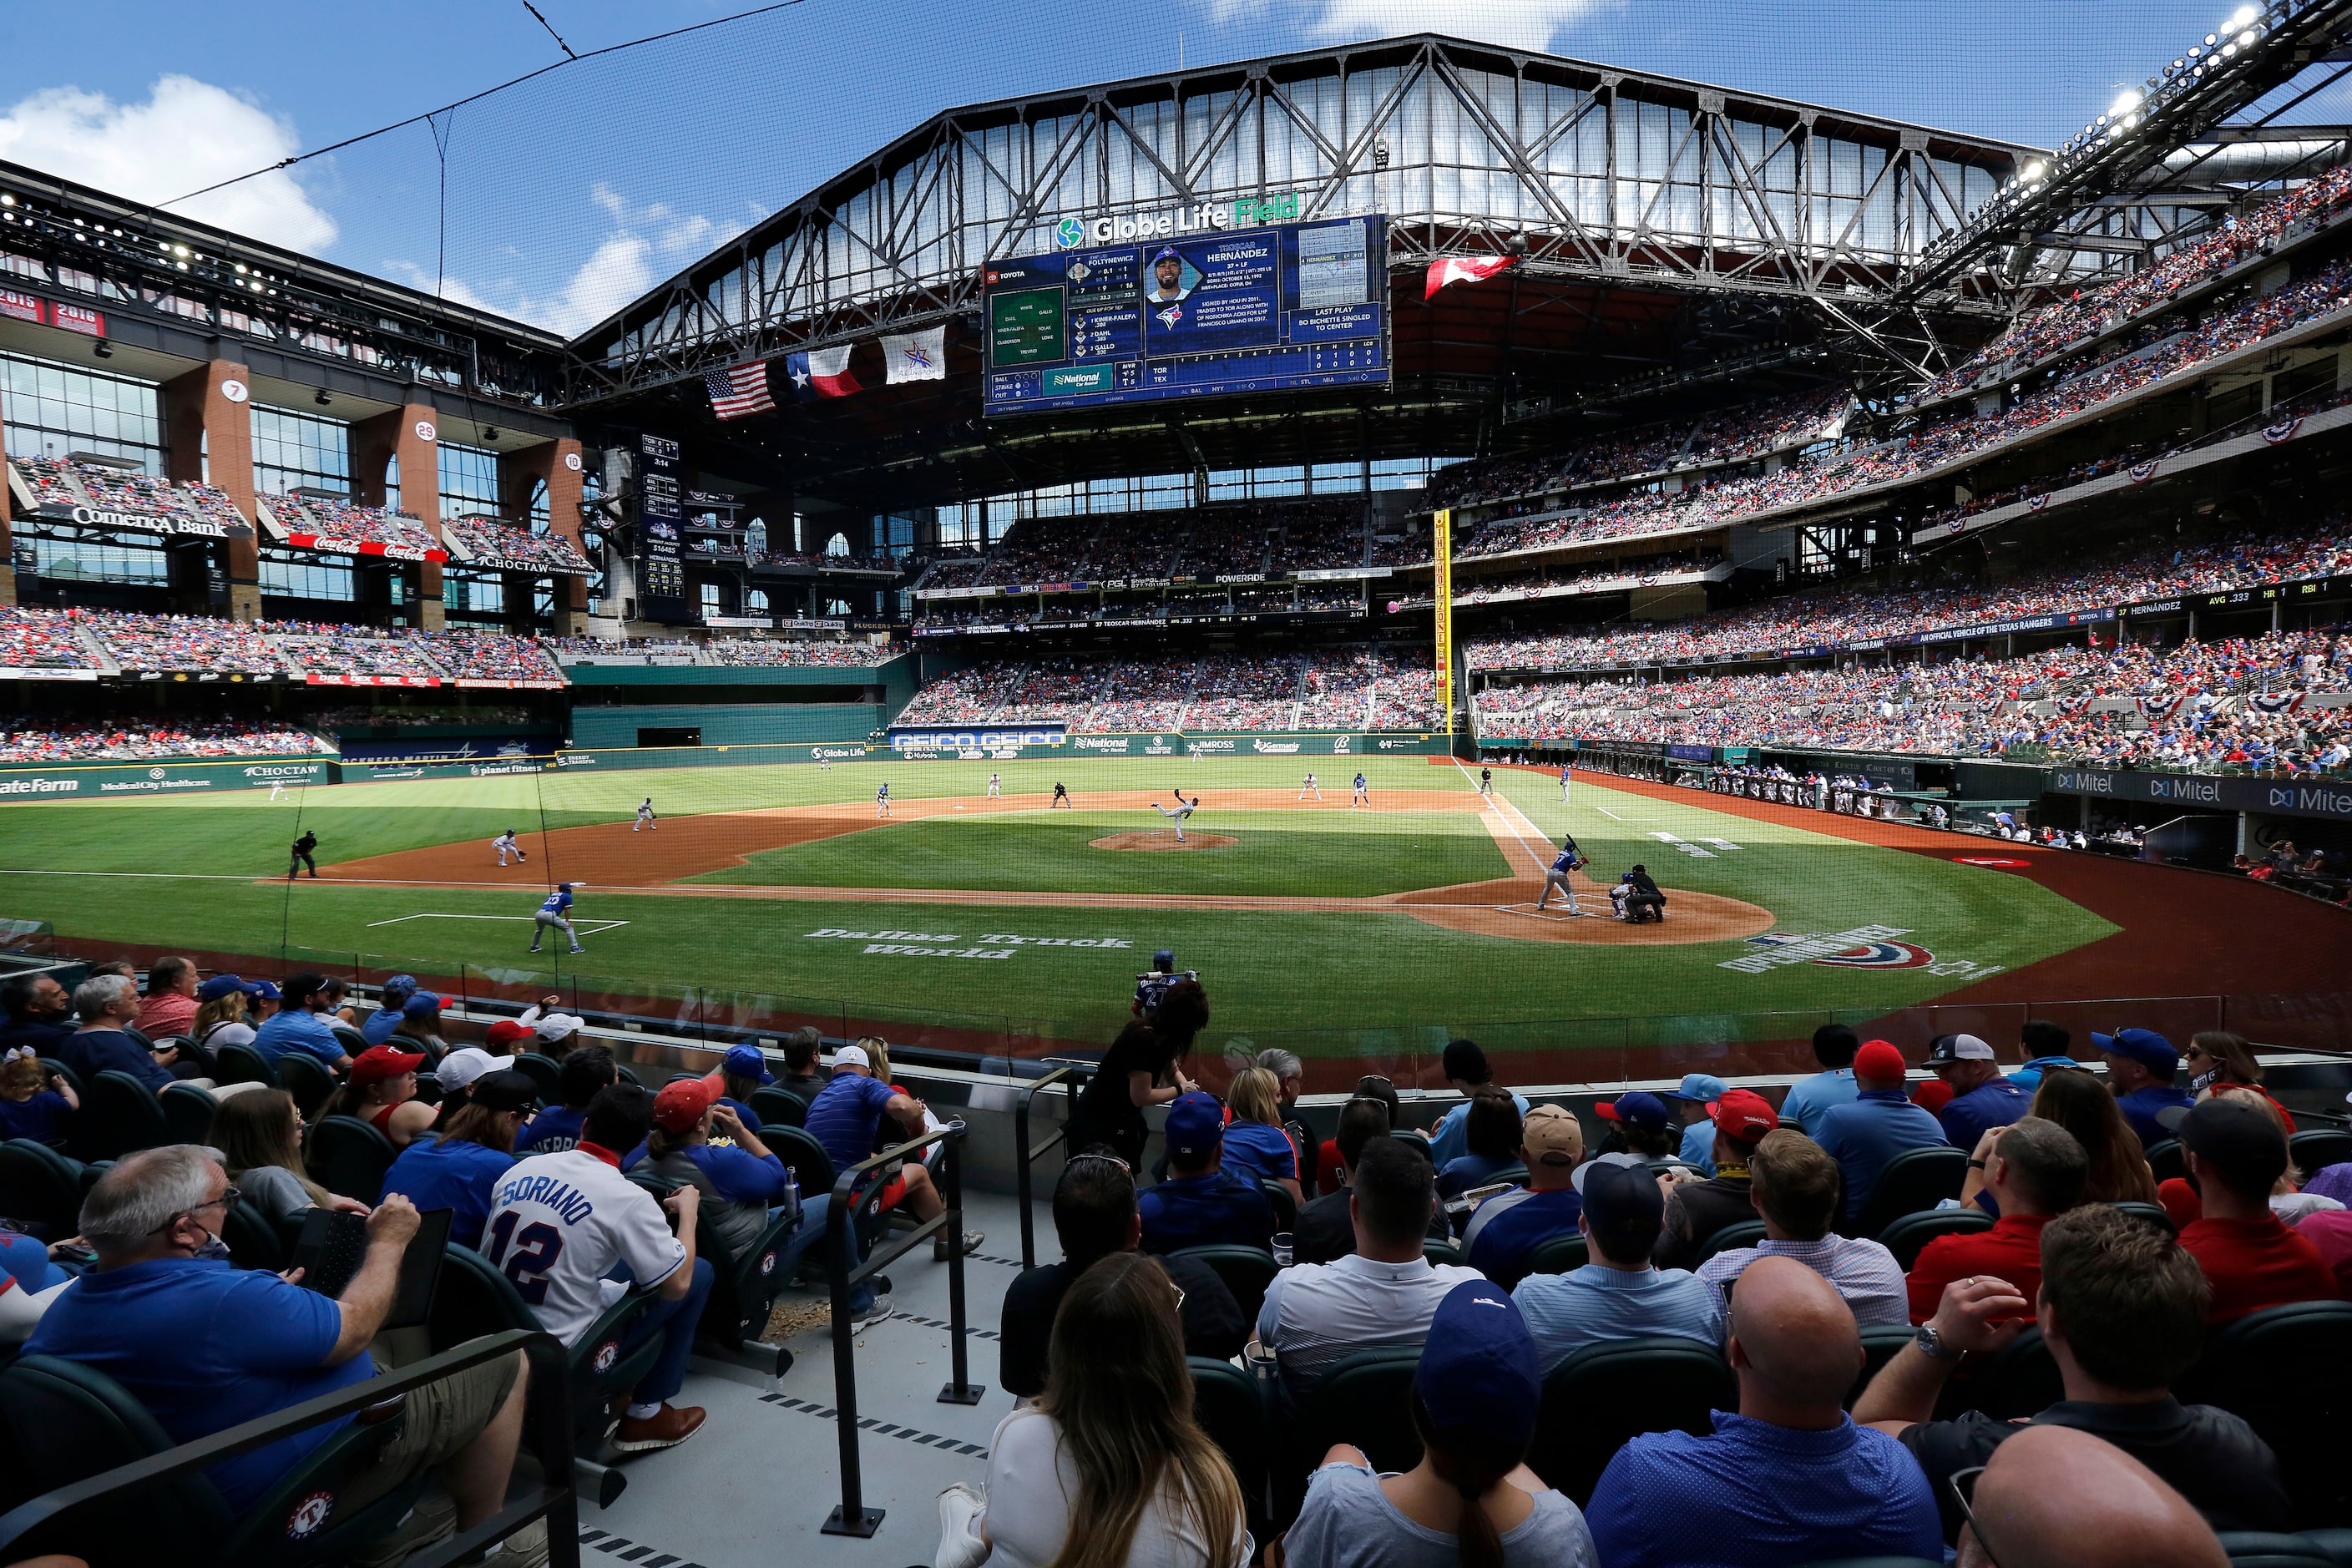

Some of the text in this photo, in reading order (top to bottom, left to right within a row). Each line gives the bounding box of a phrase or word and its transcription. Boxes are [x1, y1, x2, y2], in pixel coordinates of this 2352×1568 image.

[1093, 192, 1298, 241] Globe Life Field
[1088, 255, 1134, 266] FOLTYNEWICZ
[1207, 248, 1267, 262] HERNÁNDEZ
[999, 271, 1024, 280] TOYOTA
[58, 303, 96, 322] 2016
[1094, 314, 1136, 322] KINER-FALEFA
[1309, 316, 1341, 324] BICHETTE
[230, 384, 240, 397] 7
[417, 424, 433, 438] 29
[569, 456, 579, 467] 10
[655, 458, 668, 467] 3:14
[176, 518, 229, 537] Bank
[313, 536, 362, 554] Coca-Cola
[383, 544, 428, 562] Coca-Cola
[484, 556, 549, 574] CHOCTAW
[1215, 574, 1266, 583] POWERADE
[2131, 600, 2182, 615] HERNÁNDEZ
[2209, 596, 2226, 605] AVG
[2229, 593, 2249, 603] .333
[2263, 589, 2275, 598] HR
[2280, 587, 2286, 596] 1
[2301, 584, 2316, 594] RBI
[2322, 582, 2328, 591] 1
[1130, 618, 1166, 626] HERNÁNDEZ
[2077, 613, 2098, 621] TOYOTA
[1849, 618, 2052, 651] TOYOTA RAV4 AN OFFICIAL VEHICLE OF THE TEXAS RANGERS
[458, 679, 510, 687] WHATABURGER
[513, 680, 562, 689] WHATABURGER
[894, 732, 975, 751] GEICO
[981, 731, 1065, 751] GEICO
[824, 748, 865, 757] Globe Life
[250, 765, 319, 777] CHOCTAW
[480, 764, 542, 776] planet fitness
[101, 779, 210, 792] Medical City Healthcare
[2076, 773, 2112, 793] Mitel
[2173, 779, 2220, 802] Mitel
[803, 928, 1134, 948] Dallas Truck
[862, 943, 1018, 959] World
[1146, 987, 1167, 1006] 27
[387, 1045, 402, 1055] T
[502, 1176, 594, 1227] SORIANO
[488, 1209, 564, 1306] 12
[765, 1300, 770, 1311] 3
[604, 1404, 609, 1415] 4
